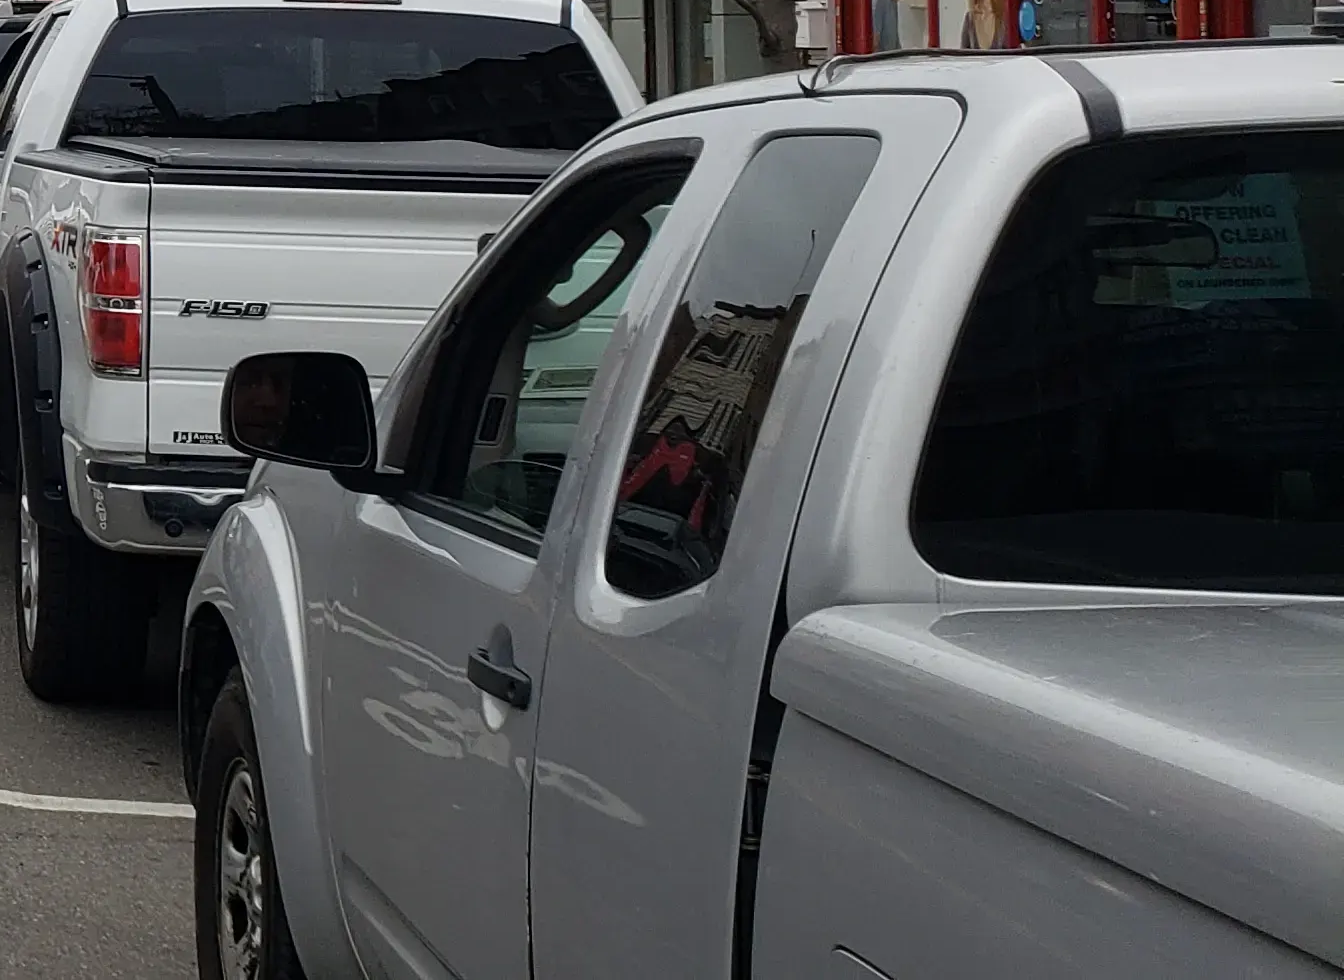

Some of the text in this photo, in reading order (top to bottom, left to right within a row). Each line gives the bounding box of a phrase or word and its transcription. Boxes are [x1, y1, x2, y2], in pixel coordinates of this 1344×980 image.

[1175, 204, 1277, 222] OFFERING
[1220, 226, 1287, 244] CLEAN
[178, 298, 270, 320] F-150
